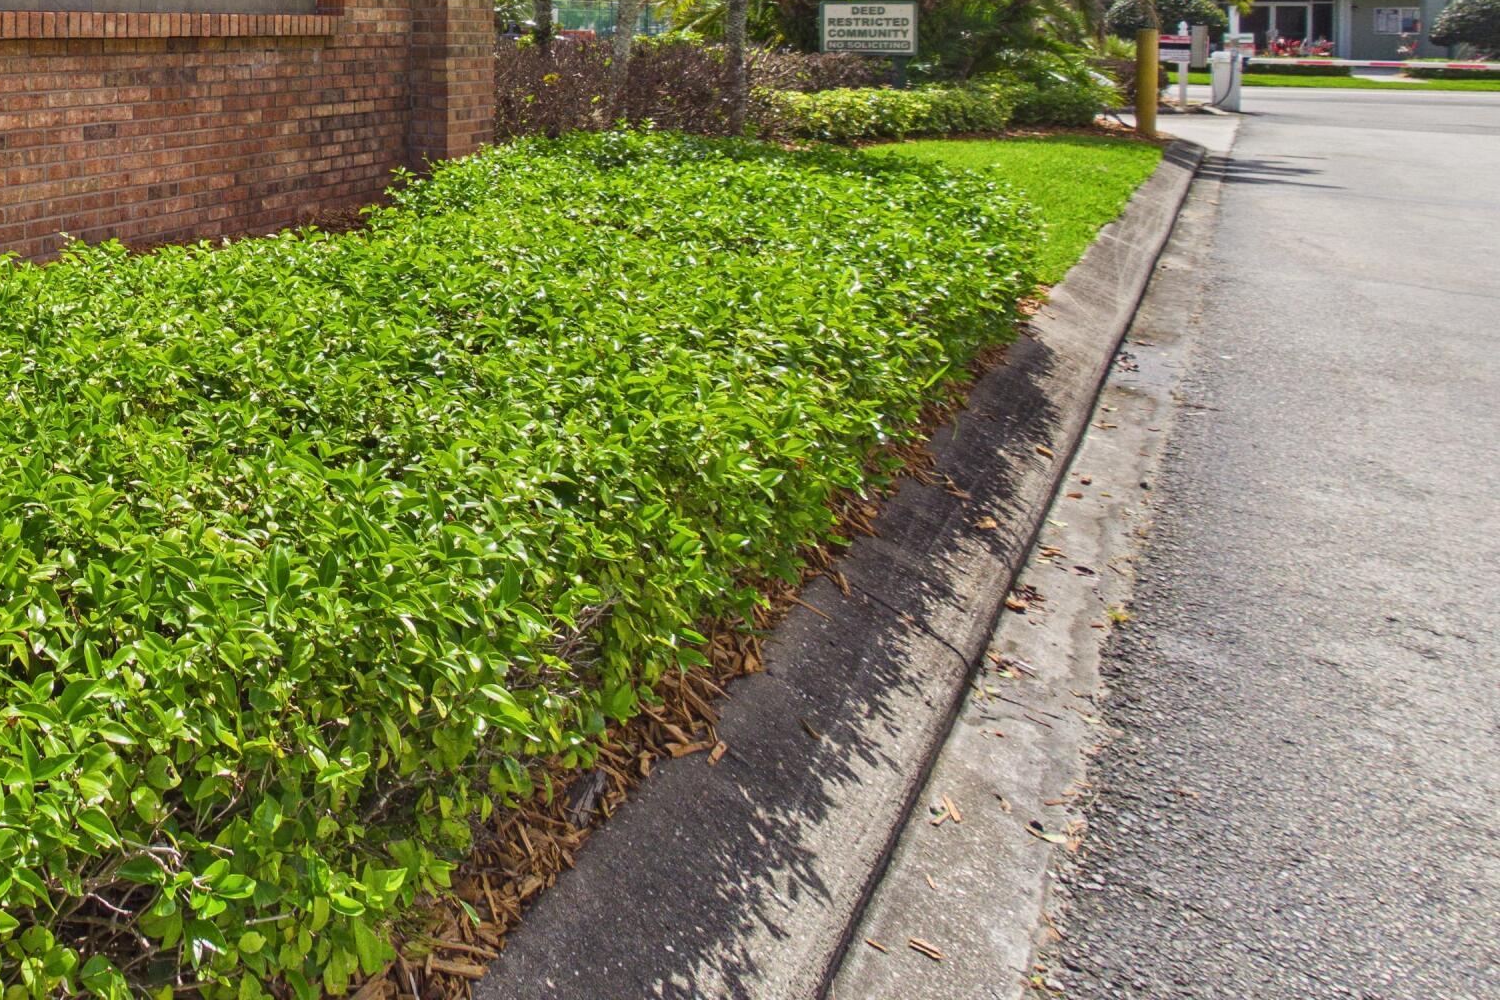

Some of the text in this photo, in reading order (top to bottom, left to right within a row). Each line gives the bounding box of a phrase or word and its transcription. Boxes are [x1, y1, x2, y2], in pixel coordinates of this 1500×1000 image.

[851, 6, 886, 15] DEED
[827, 17, 909, 27] RESTRICTED
[828, 28, 909, 38] COMMUNITY
[828, 41, 909, 49] NO SOLICITING
